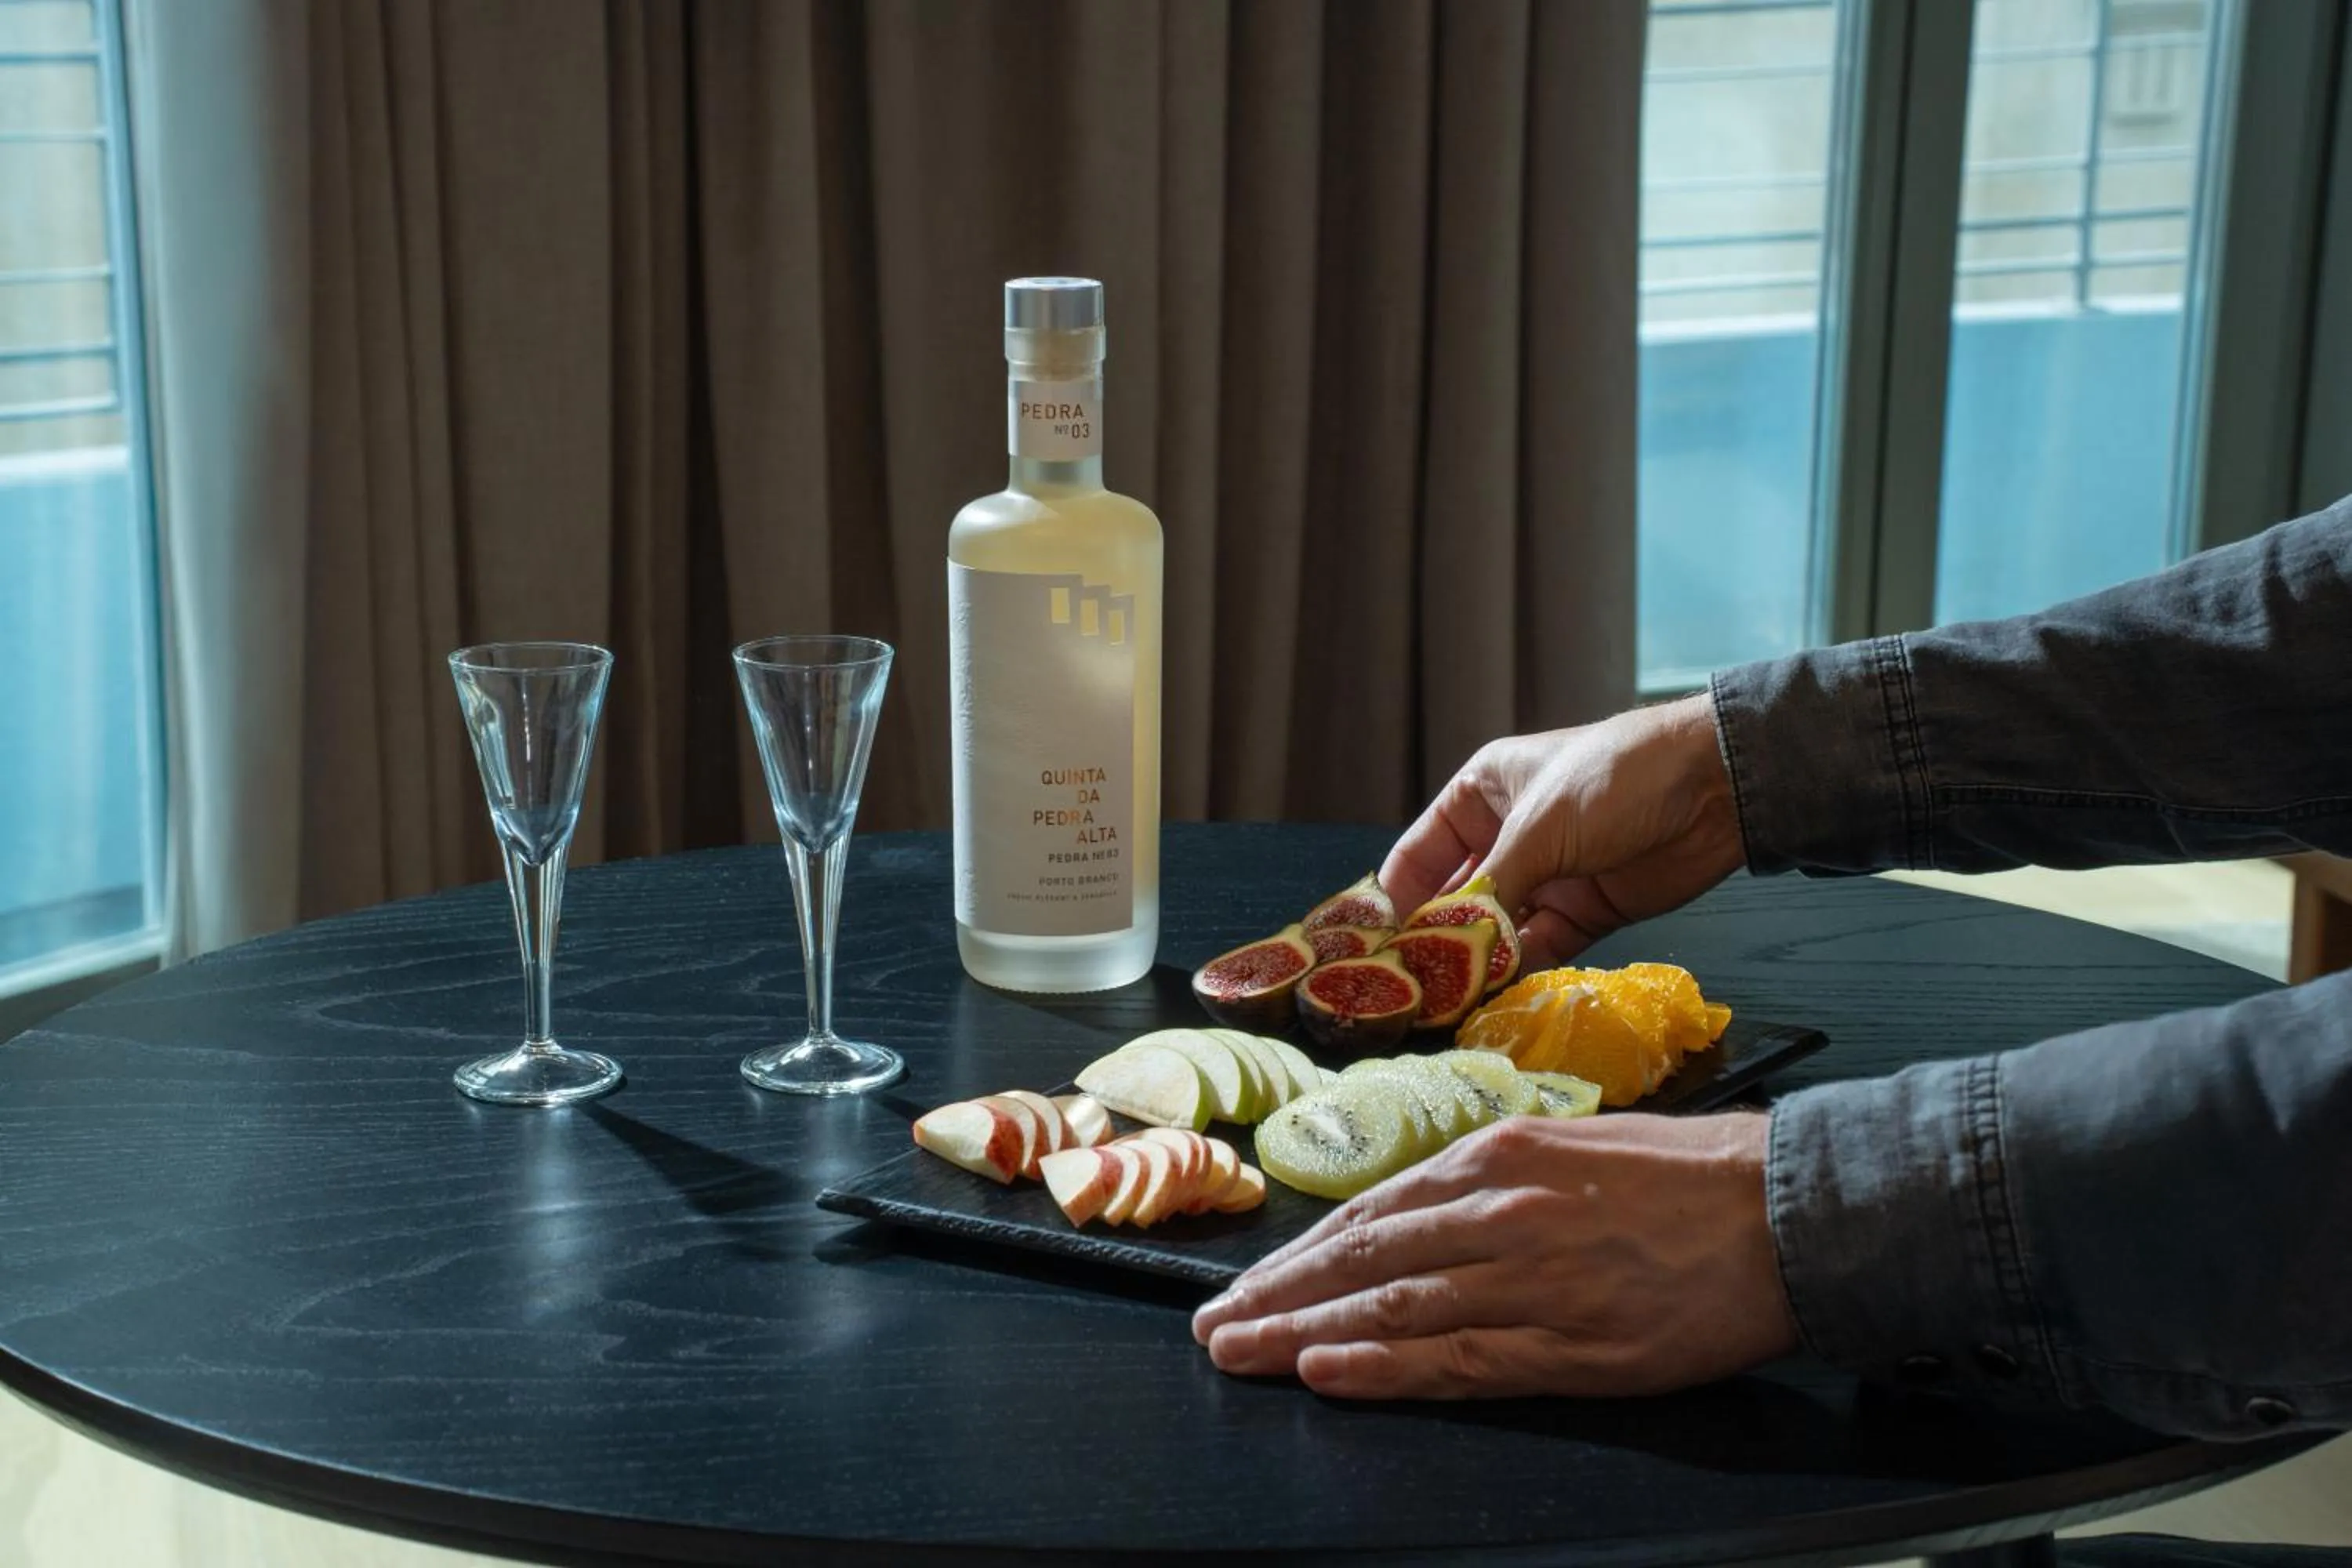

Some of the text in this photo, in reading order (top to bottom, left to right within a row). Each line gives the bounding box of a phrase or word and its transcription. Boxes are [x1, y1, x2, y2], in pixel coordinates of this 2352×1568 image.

[1022, 401, 1084, 419] PEDRA
[1041, 768, 1106, 786] QUINTA
[1078, 789, 1100, 804] DA
[1033, 809, 1094, 826] PEDRA
[1076, 826, 1117, 844] ALTA
[1048, 853, 1088, 863] PEDRA
[1039, 873, 1119, 886] PORTO BRANCO
